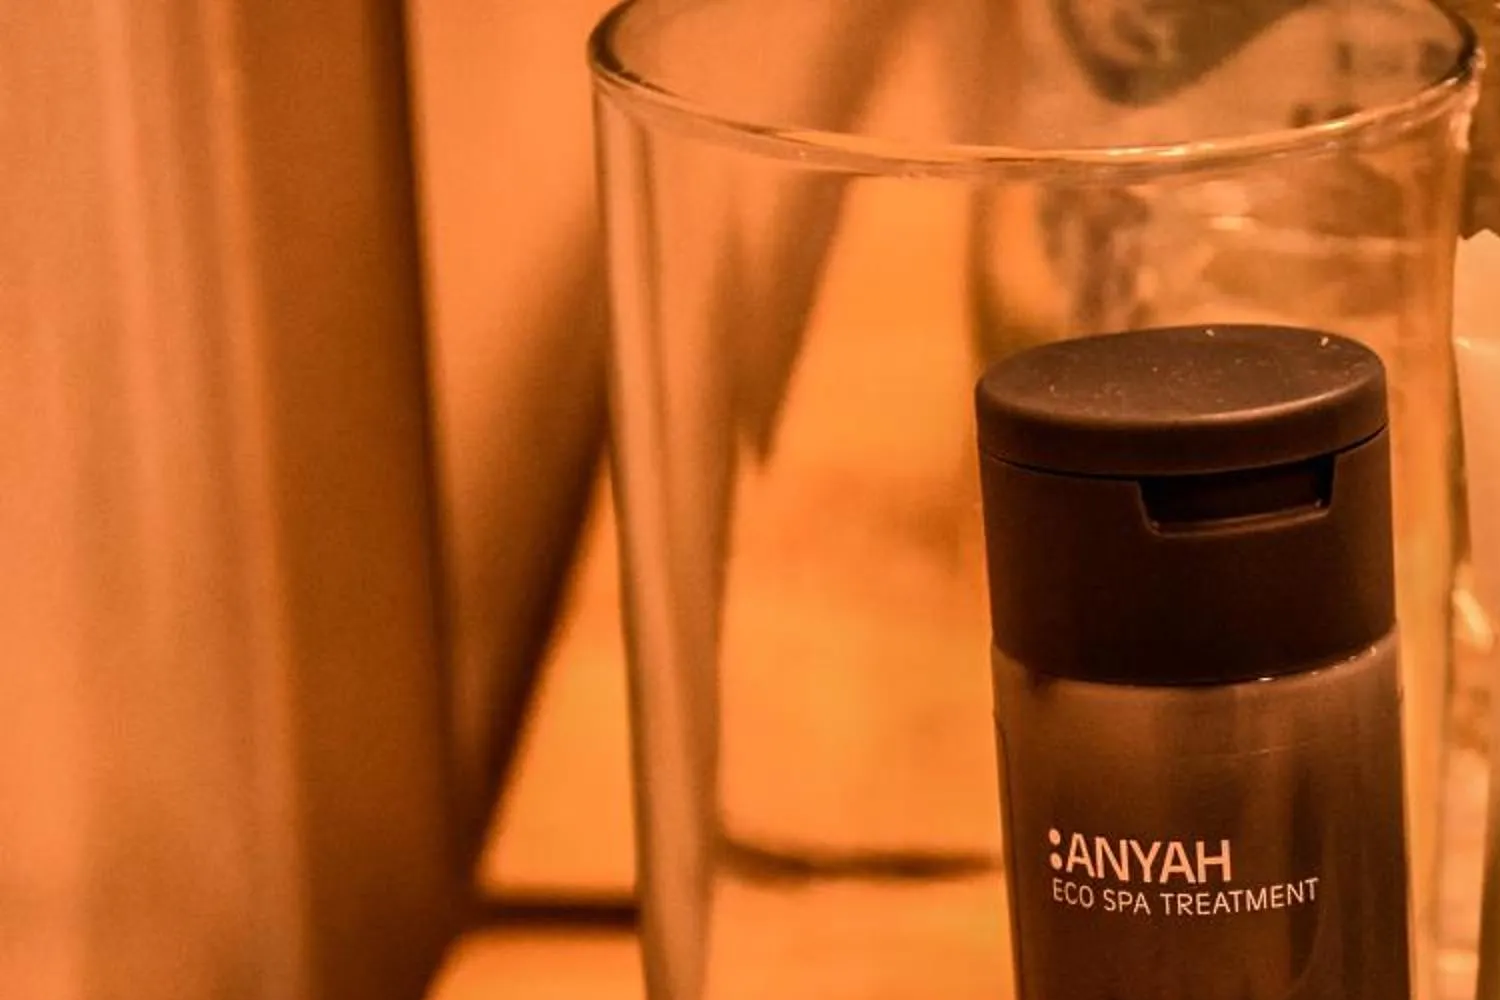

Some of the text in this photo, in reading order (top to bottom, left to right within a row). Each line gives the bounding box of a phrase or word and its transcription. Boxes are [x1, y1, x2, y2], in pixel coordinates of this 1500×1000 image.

[1052, 877, 1320, 916] ECO SPA TREATMENT
